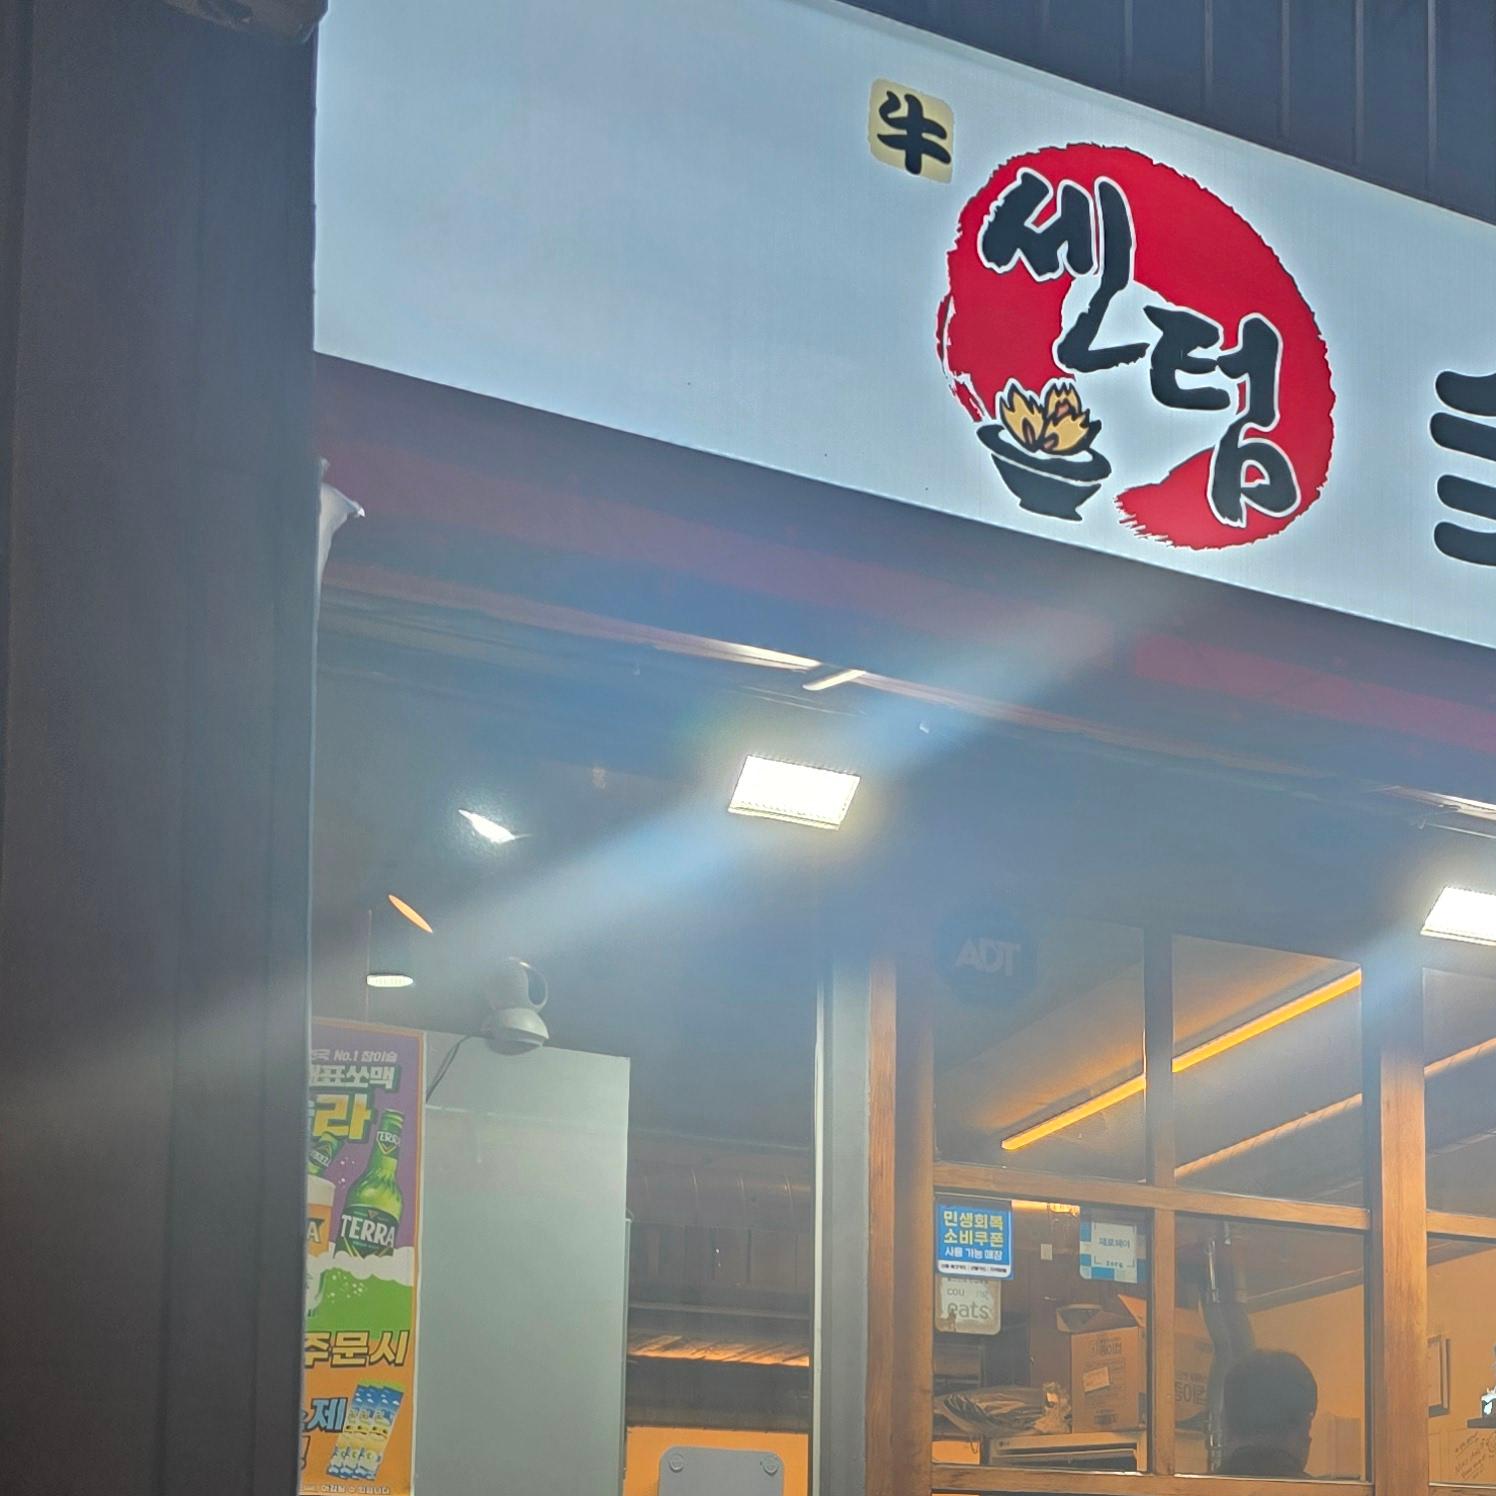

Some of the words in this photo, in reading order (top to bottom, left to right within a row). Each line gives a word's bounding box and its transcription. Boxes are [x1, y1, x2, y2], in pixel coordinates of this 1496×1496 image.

[877, 90, 952, 175] 牛
[954, 937, 1020, 976] ADT
[341, 1215, 396, 1249] TERRA
[943, 1210, 1004, 1231] 민생회복
[943, 1228, 1004, 1248] 소비쿠폰
